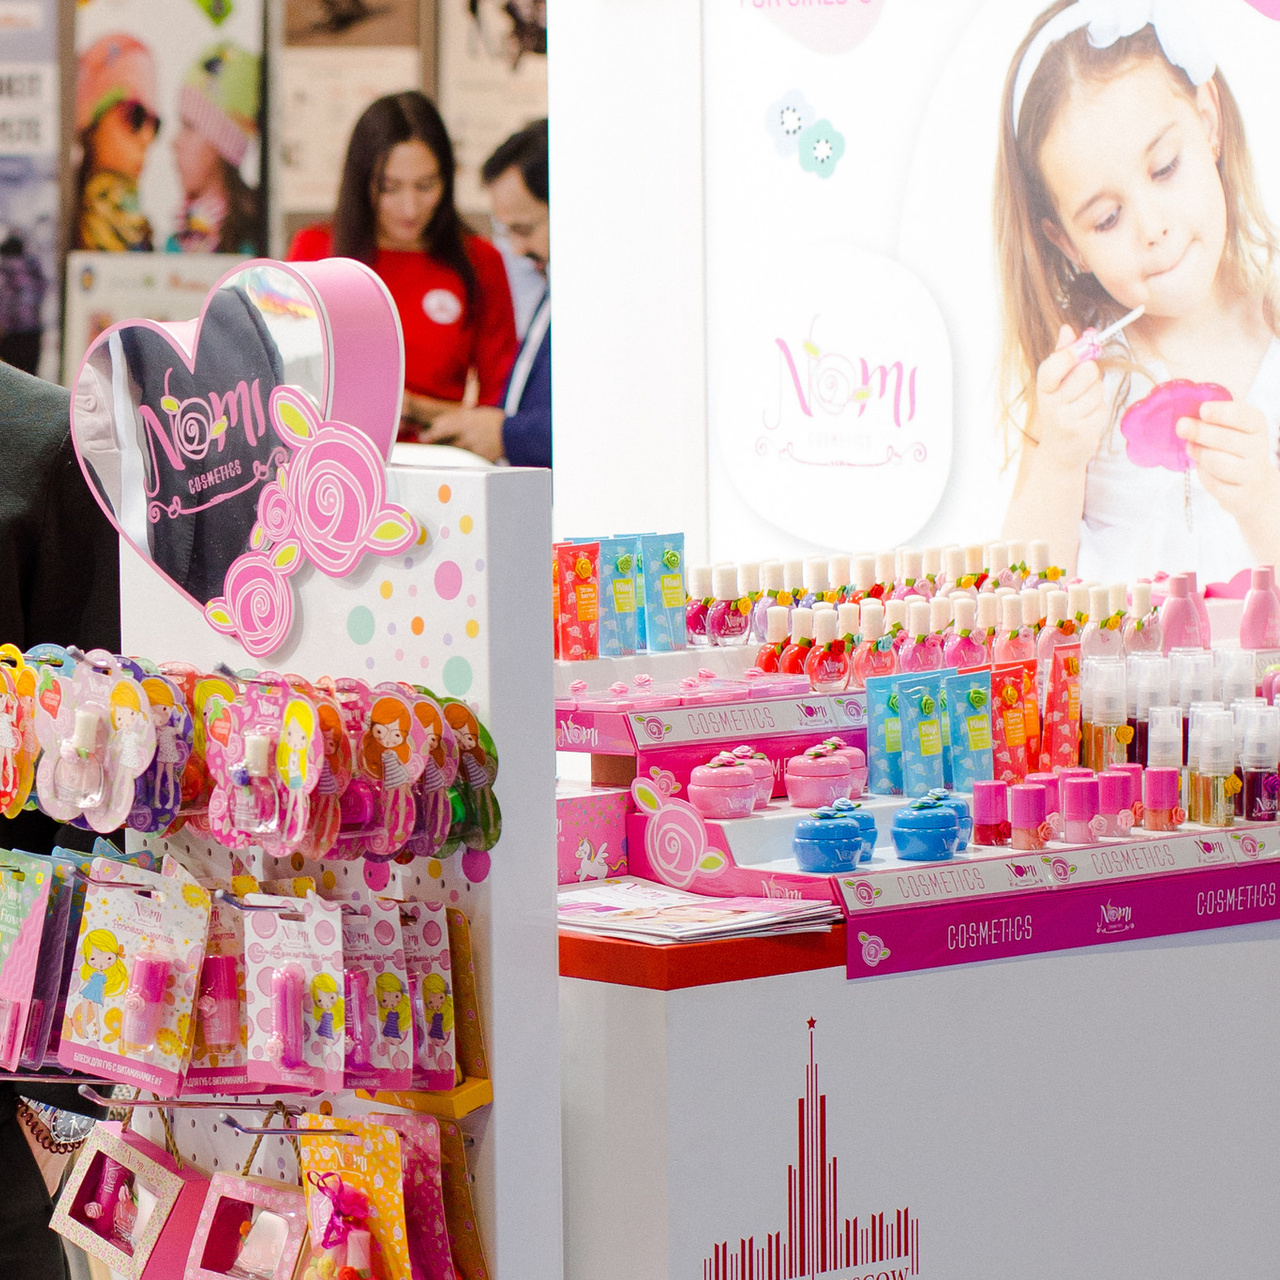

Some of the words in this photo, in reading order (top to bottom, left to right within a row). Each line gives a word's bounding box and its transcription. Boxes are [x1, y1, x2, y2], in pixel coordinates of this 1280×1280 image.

[188, 459, 242, 495] COSMETICS
[687, 707, 776, 736] COSMETICS
[1091, 844, 1177, 875] COSMETICS
[897, 867, 986, 899] COSMETICS
[947, 915, 1033, 951] COSMETICS
[1196, 883, 1277, 916] COSMETICS
